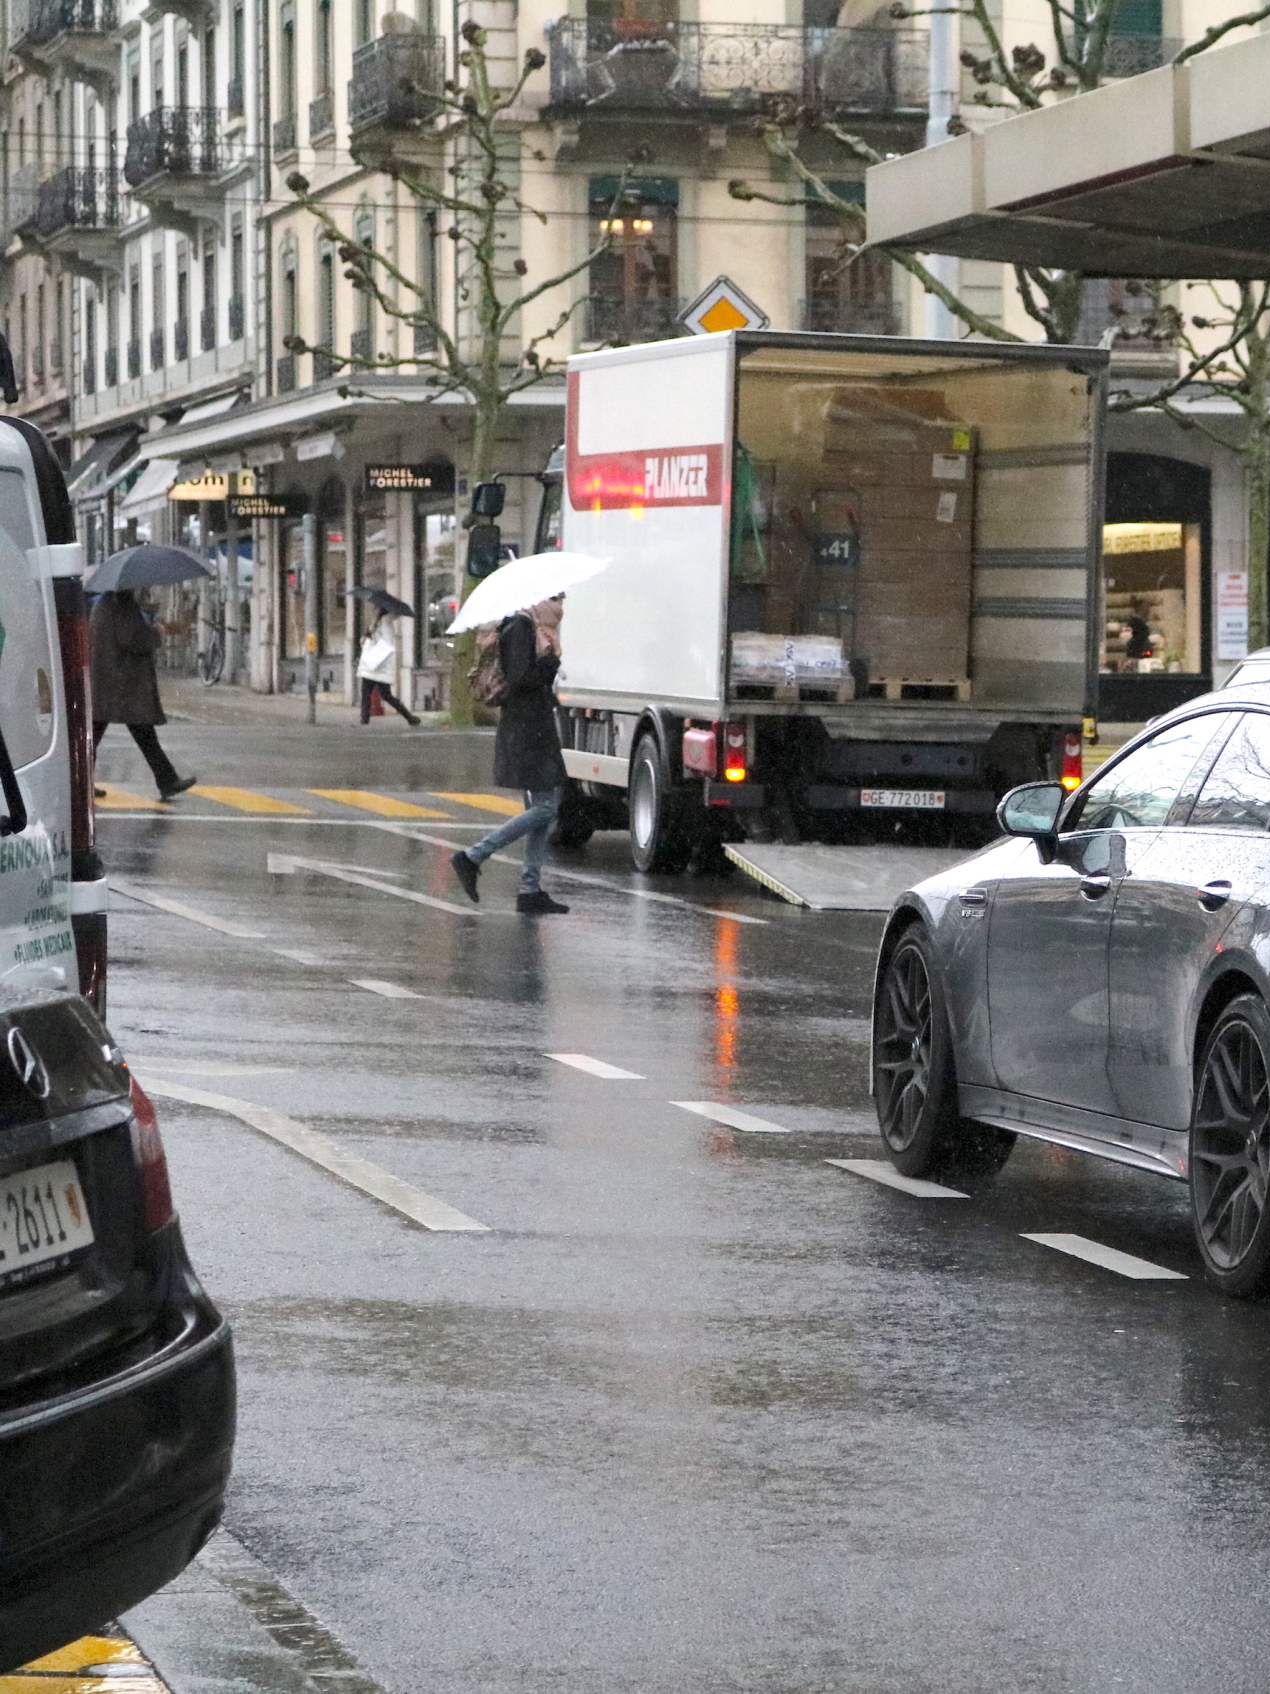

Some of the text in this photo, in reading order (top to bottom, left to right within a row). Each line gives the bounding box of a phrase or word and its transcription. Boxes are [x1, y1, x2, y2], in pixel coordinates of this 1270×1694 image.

[369, 467, 413, 478] MICHEL
[645, 453, 709, 499] PLANZER
[369, 477, 433, 489] FORESTIER
